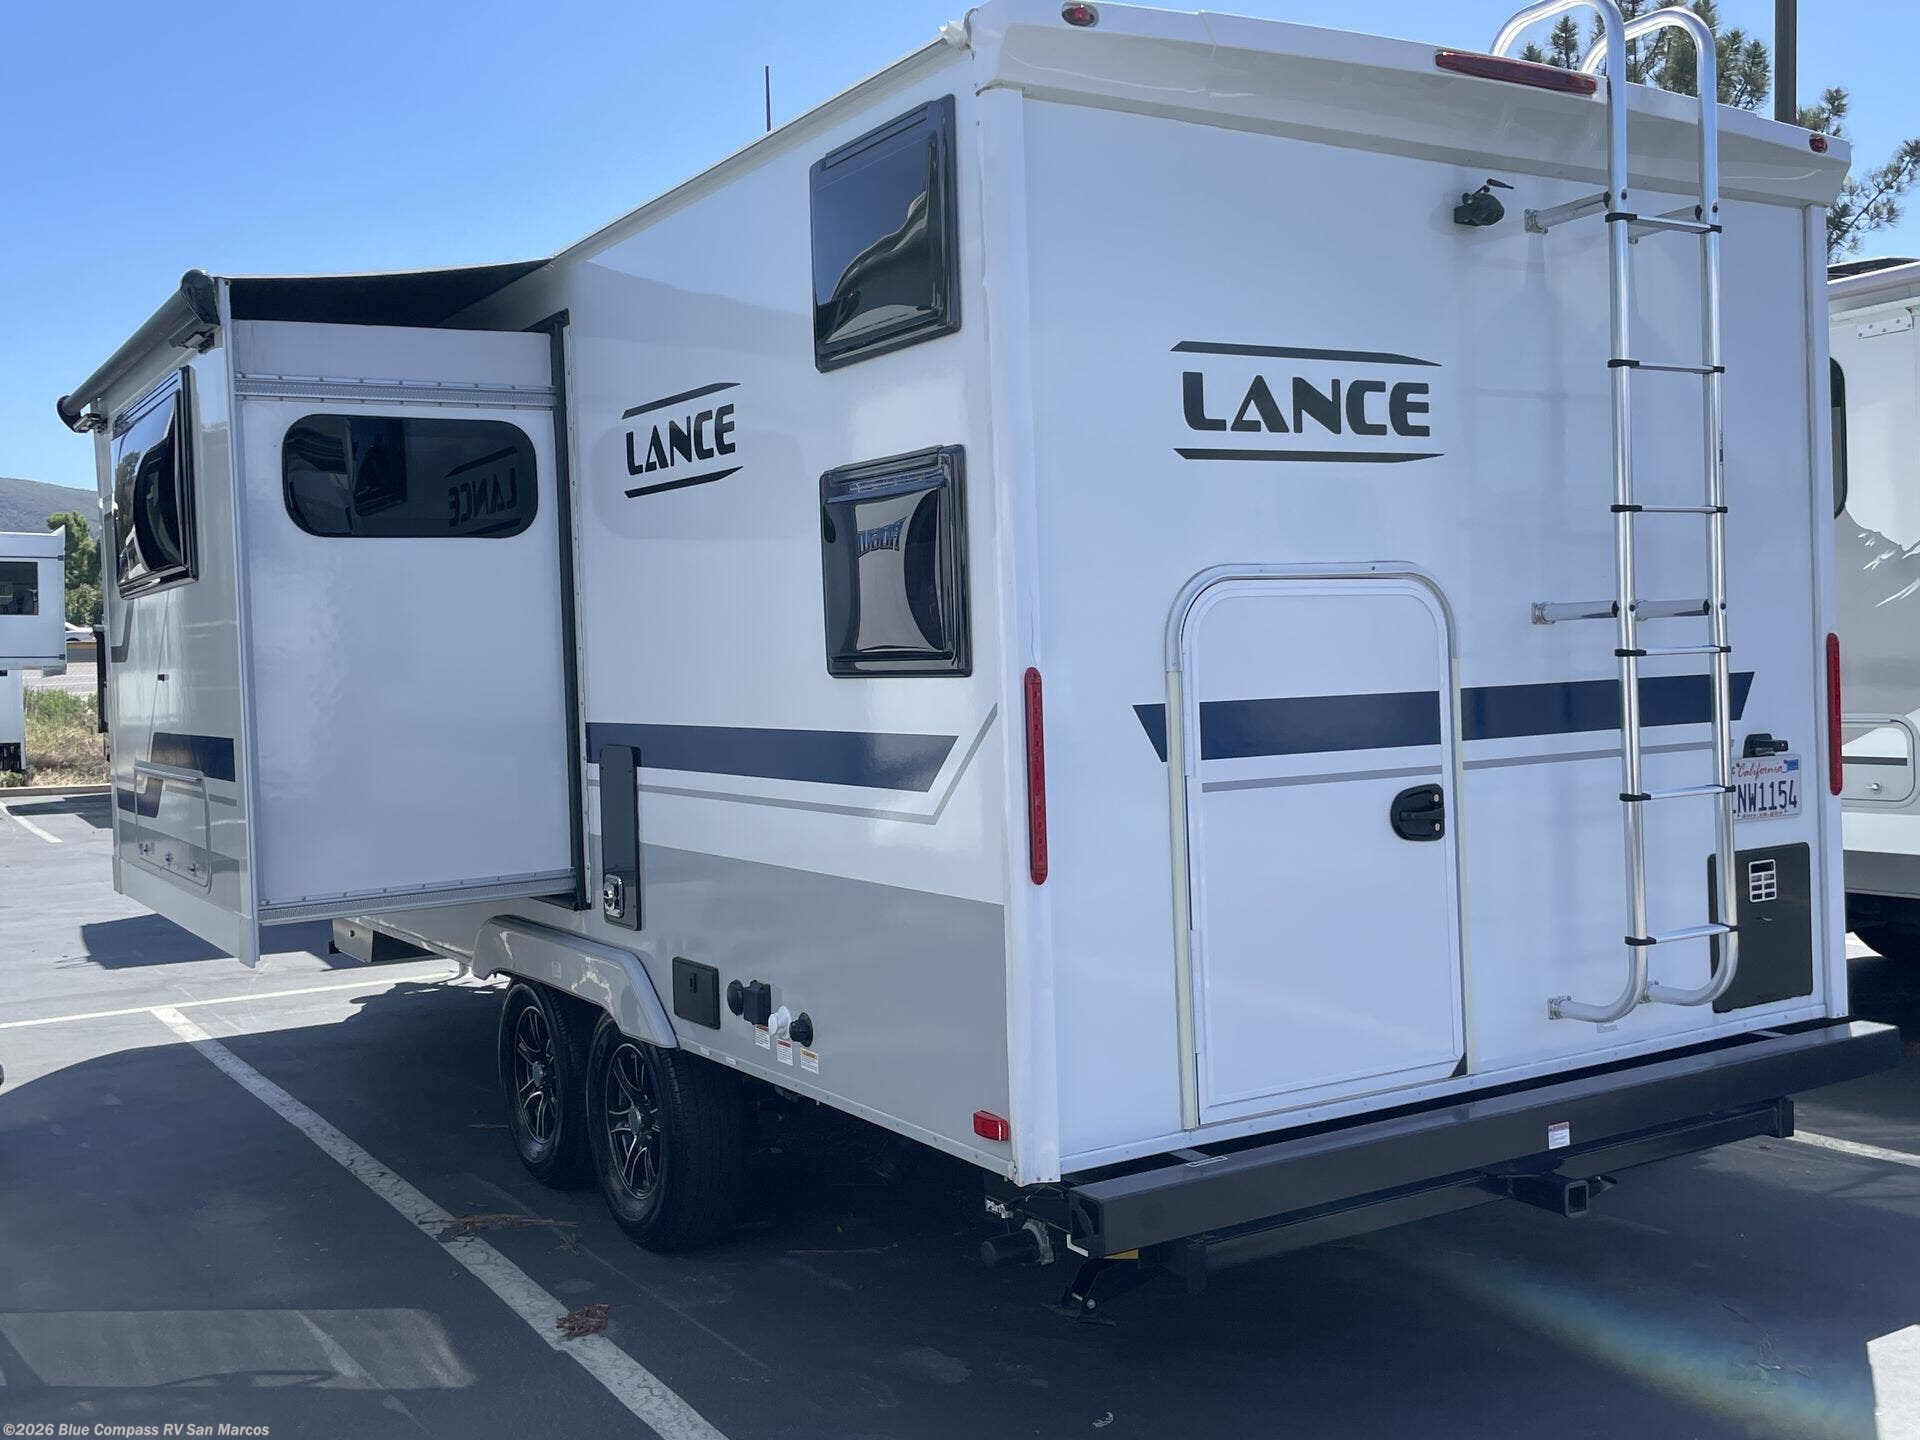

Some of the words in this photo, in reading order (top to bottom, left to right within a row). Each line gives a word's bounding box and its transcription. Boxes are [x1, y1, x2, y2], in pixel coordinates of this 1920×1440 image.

[1182, 371, 1431, 437] LANCE
[626, 403, 736, 476] LANCE
[1738, 762, 1786, 779] California
[1733, 780, 1798, 815] NW1154
